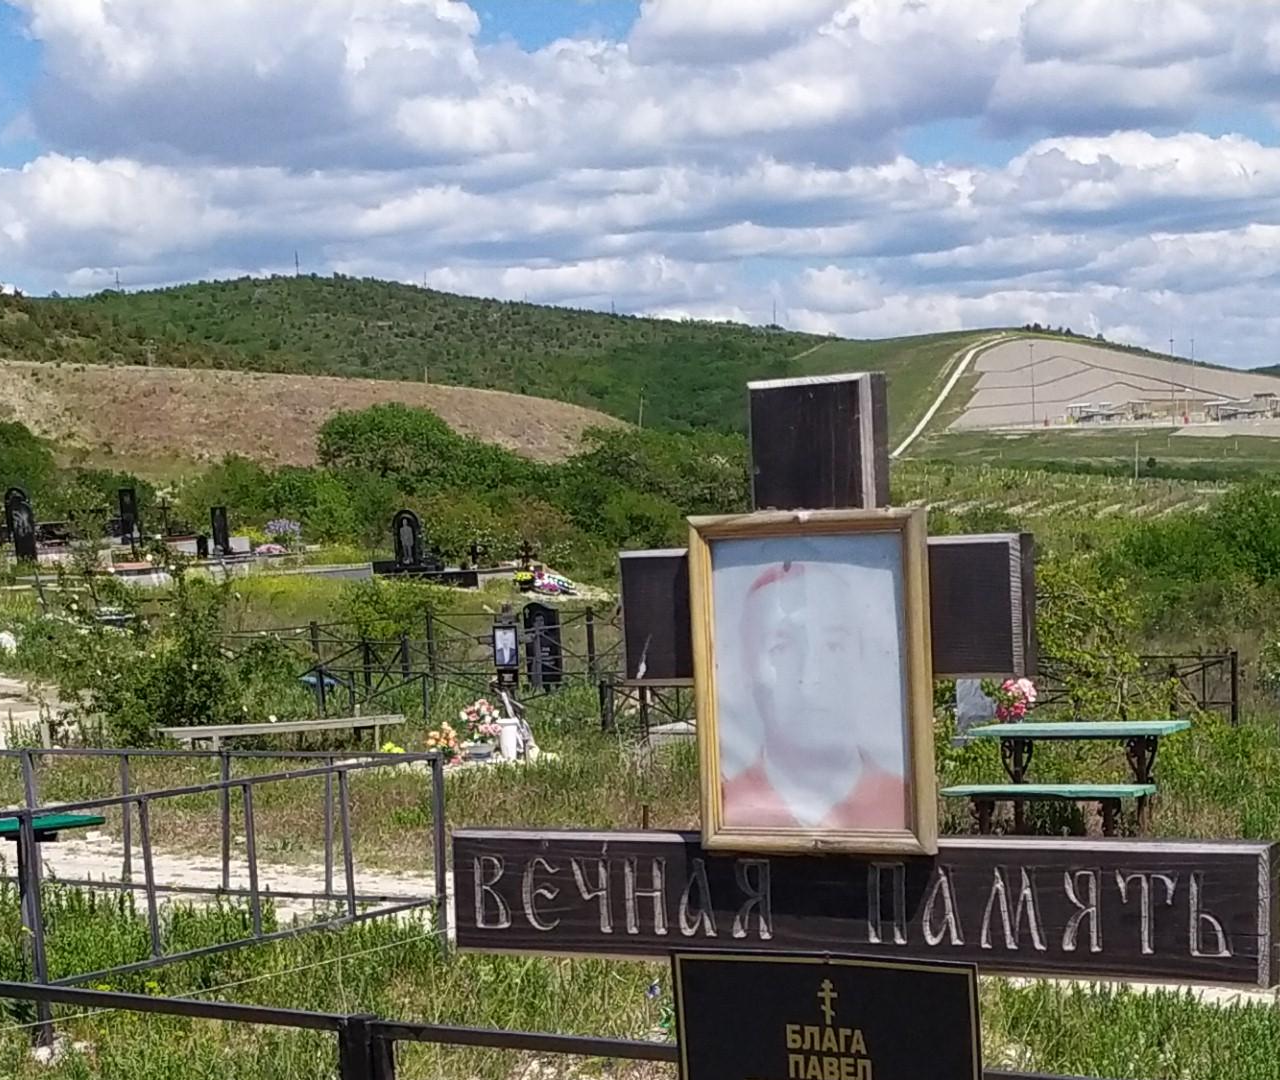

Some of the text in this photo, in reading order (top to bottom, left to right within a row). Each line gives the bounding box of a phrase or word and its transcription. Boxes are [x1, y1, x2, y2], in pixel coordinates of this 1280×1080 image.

[474, 855, 1233, 957] ВЕЧНАЯ ПАМЯТЬ
[786, 1024, 867, 1054] БЛАГА
